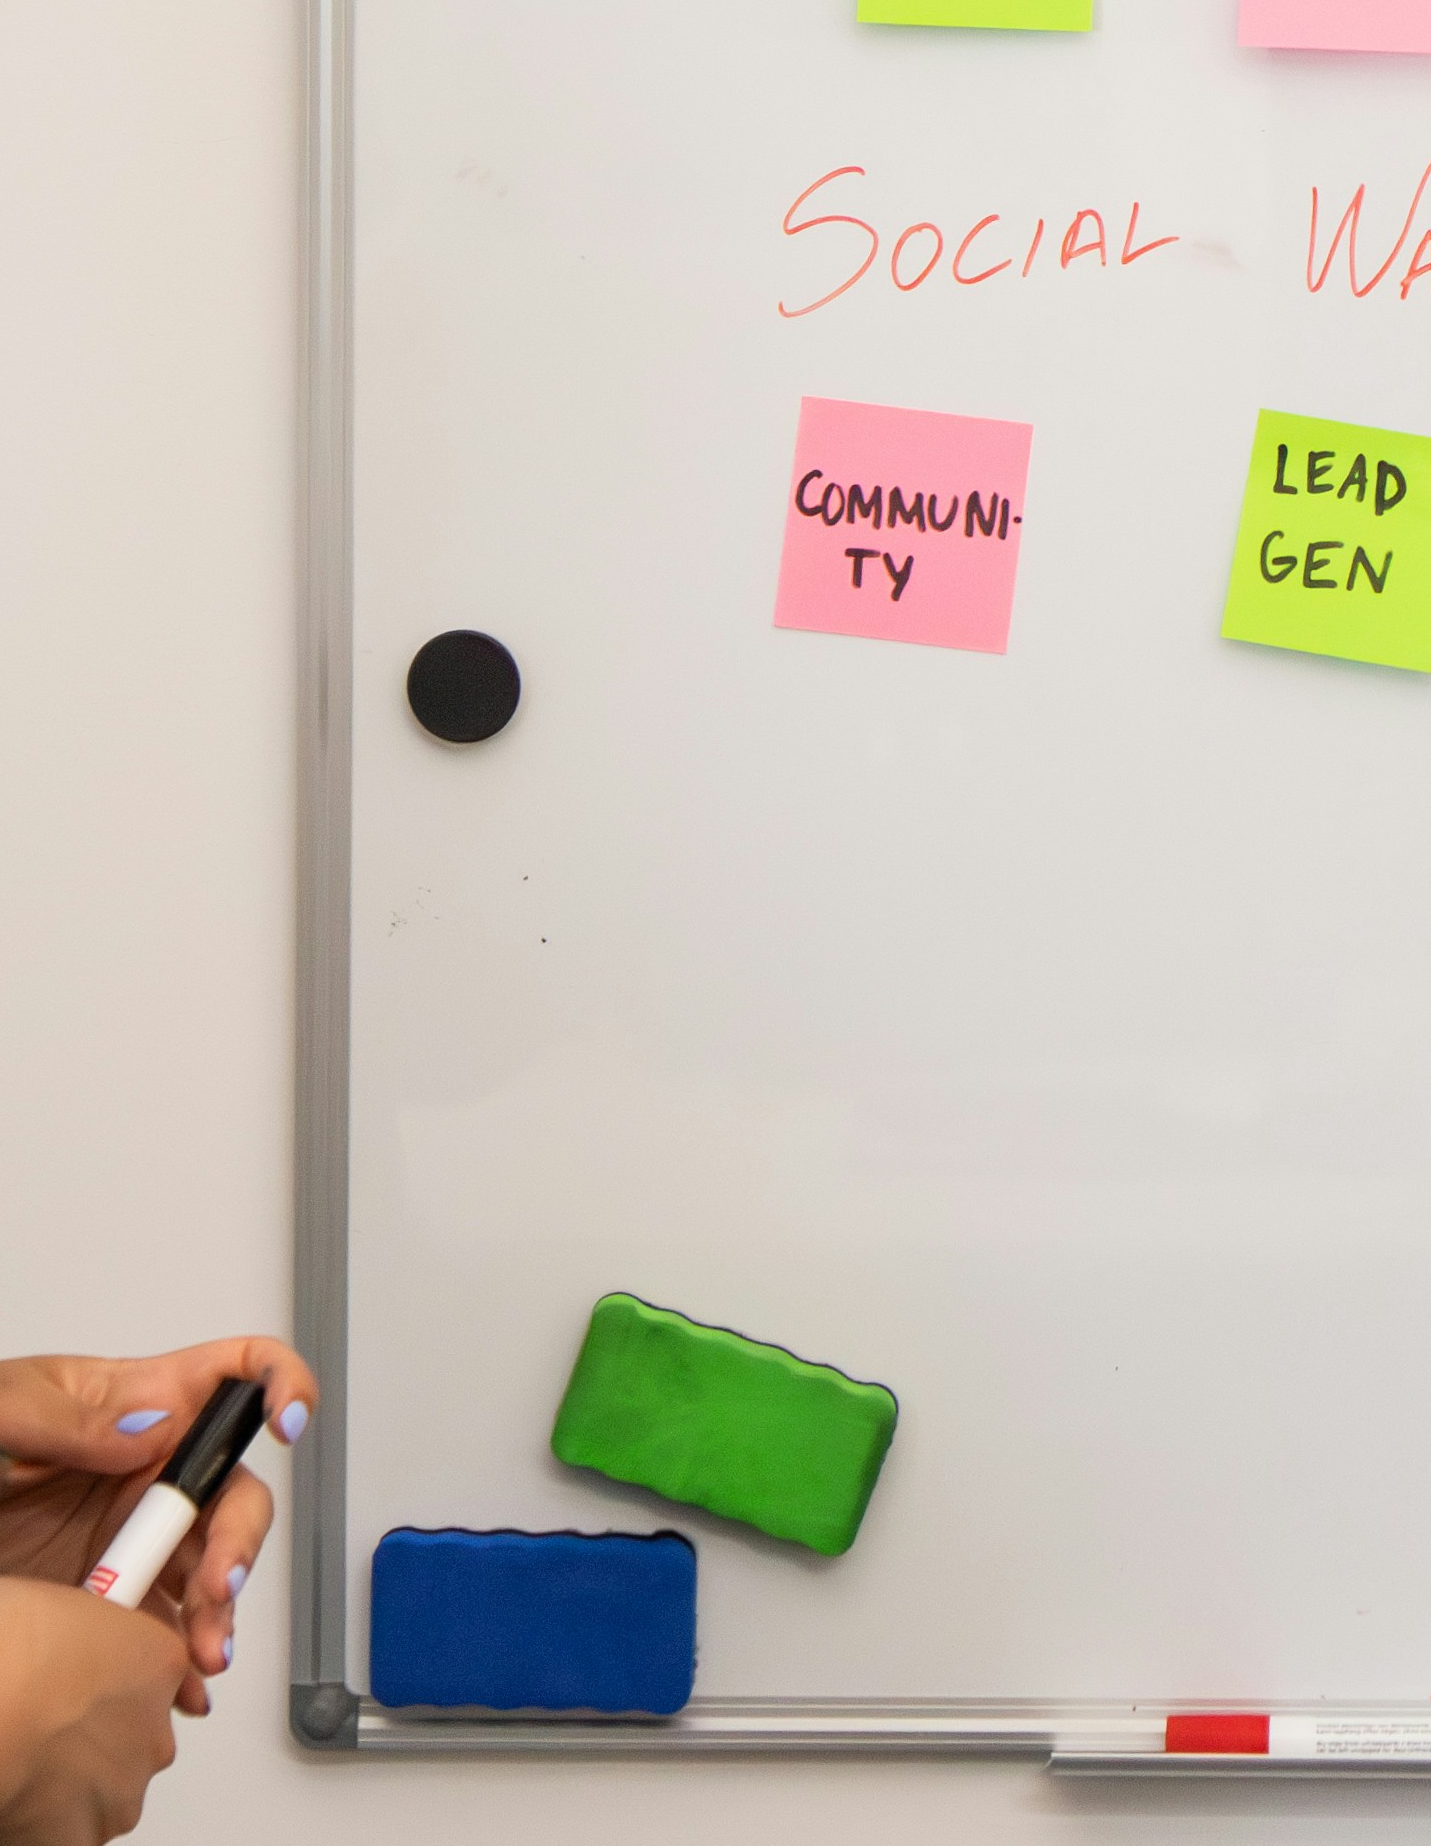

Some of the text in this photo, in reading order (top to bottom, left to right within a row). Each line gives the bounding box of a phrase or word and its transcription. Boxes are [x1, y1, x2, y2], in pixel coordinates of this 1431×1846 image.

[777, 165, 1181, 319] SOCIAL
[1272, 442, 1409, 518] LEAD
[843, 546, 915, 603] TY
[1258, 528, 1395, 596] GEN
